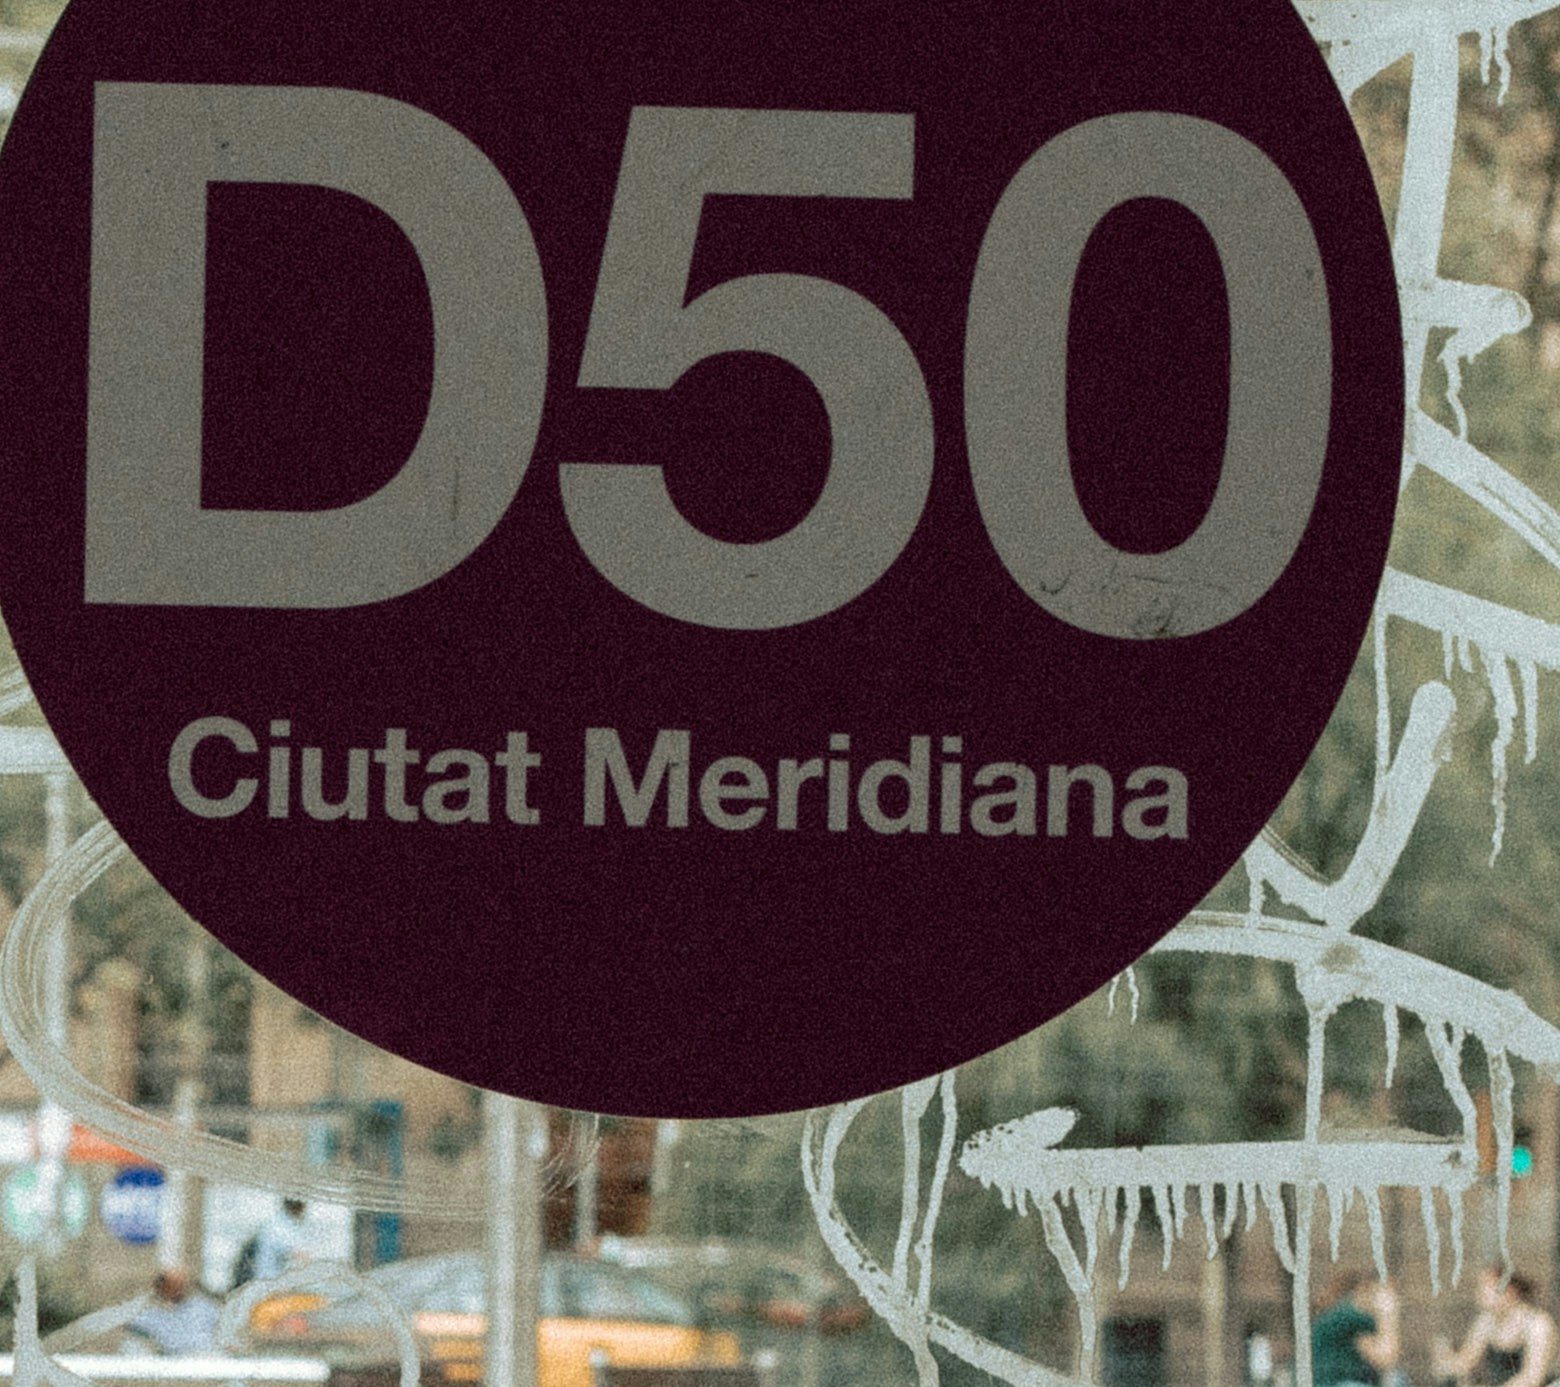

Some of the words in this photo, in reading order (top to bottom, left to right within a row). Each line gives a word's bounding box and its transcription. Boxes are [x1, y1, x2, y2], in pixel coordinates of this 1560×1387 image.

[83, 81, 1333, 640] D50
[166, 716, 541, 826] Ciutat
[583, 727, 1190, 842] Meridiana
